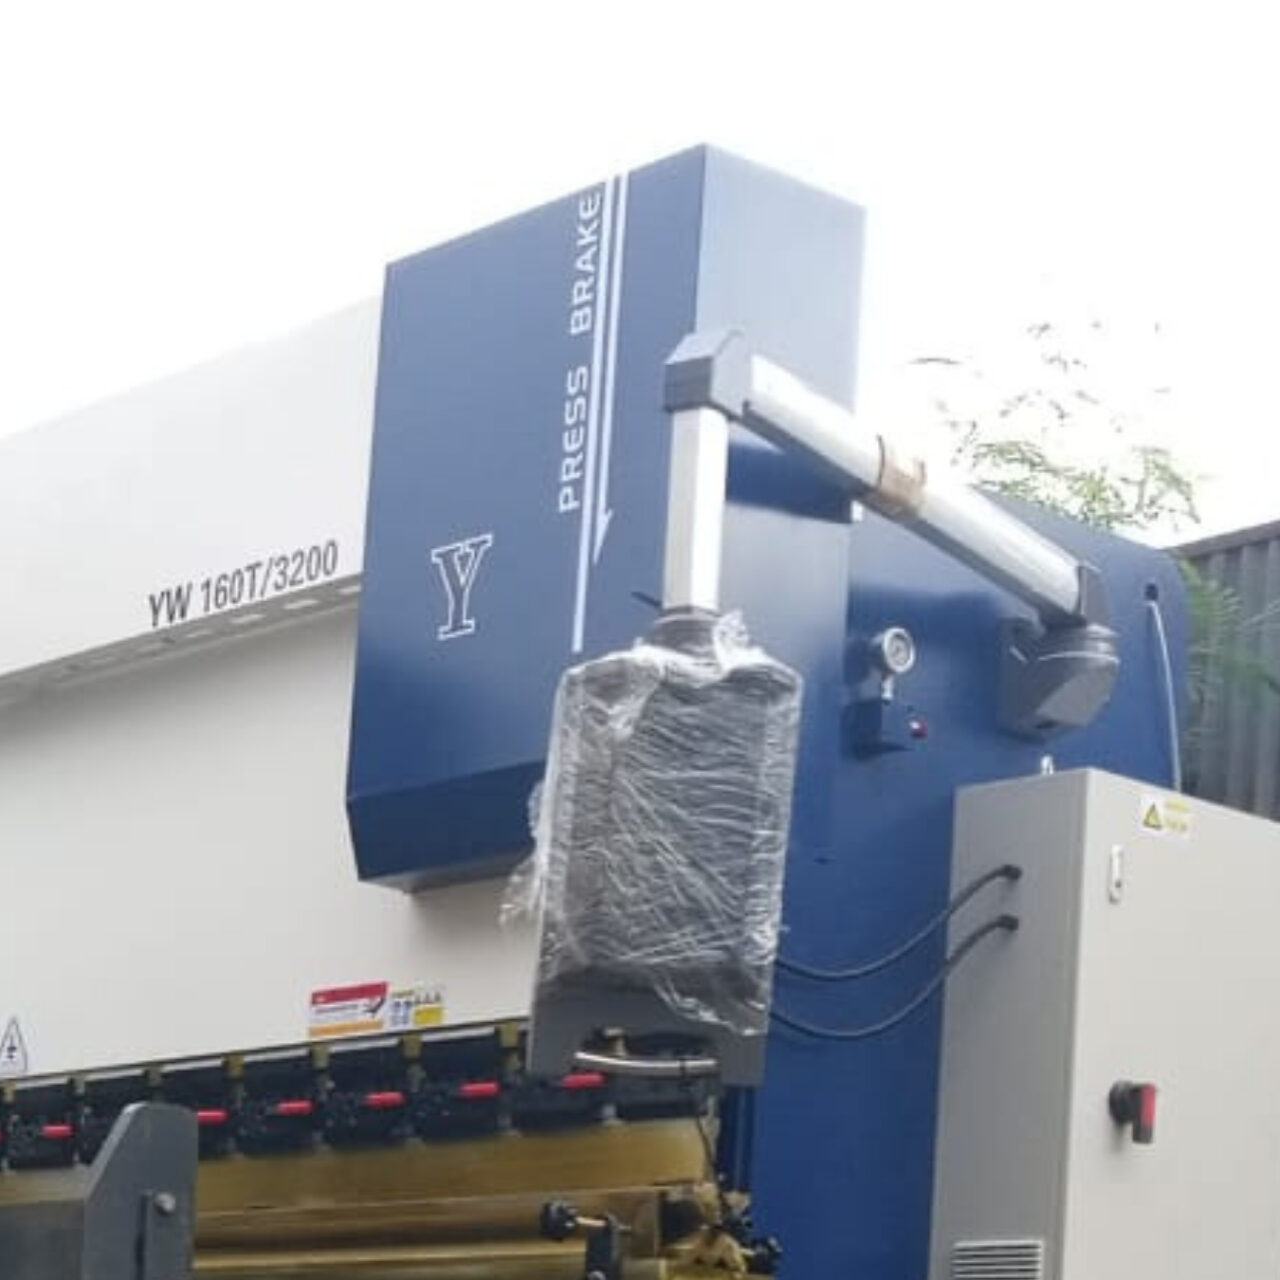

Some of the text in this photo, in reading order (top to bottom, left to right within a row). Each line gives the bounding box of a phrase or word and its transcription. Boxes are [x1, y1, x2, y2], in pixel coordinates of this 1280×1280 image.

[559, 191, 601, 514] PRESS BRAKE
[149, 539, 339, 628] YW 160T/3200
[431, 533, 493, 640] Y
